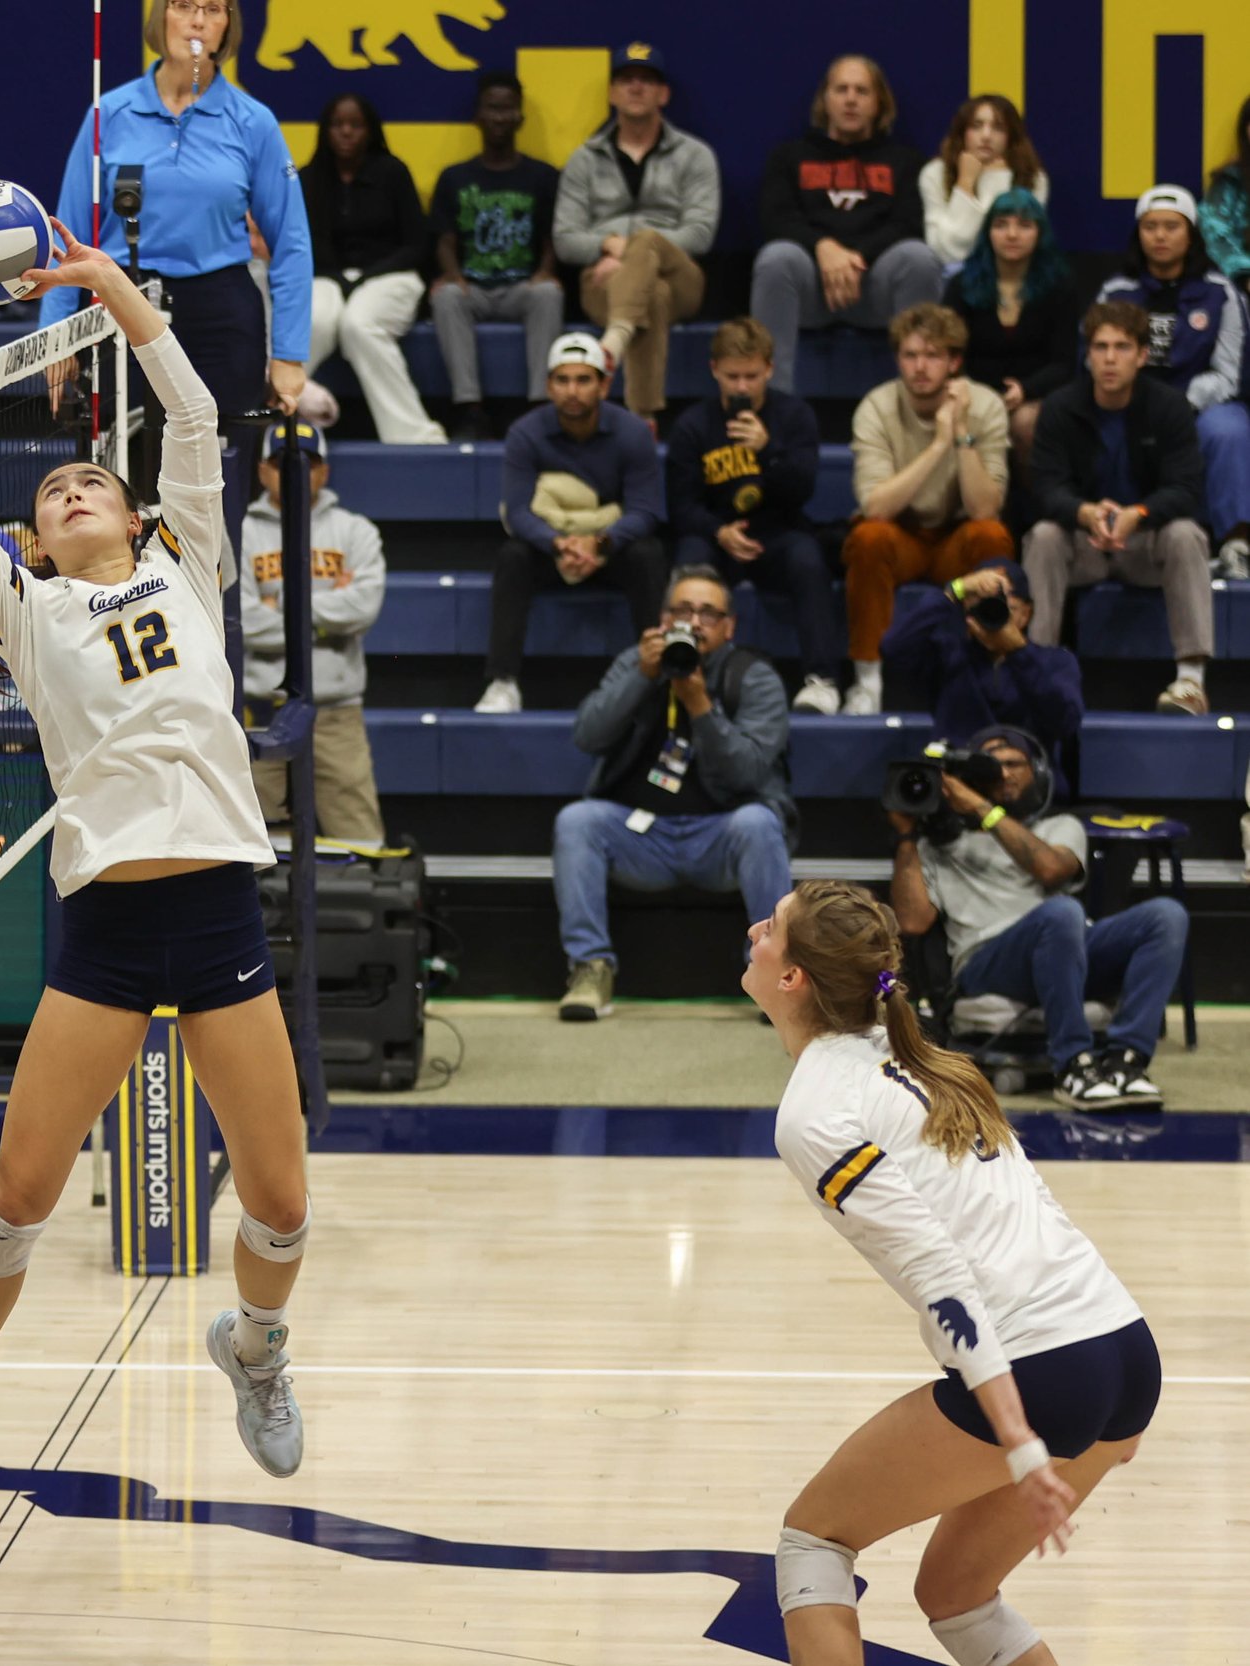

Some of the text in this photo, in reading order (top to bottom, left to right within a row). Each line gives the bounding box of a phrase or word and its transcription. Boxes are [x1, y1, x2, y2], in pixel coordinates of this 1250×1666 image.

[827, 189, 868, 211] VT
[89, 574, 169, 620] California
[103, 609, 180, 686] 12
[142, 1051, 171, 1228] sports imports
